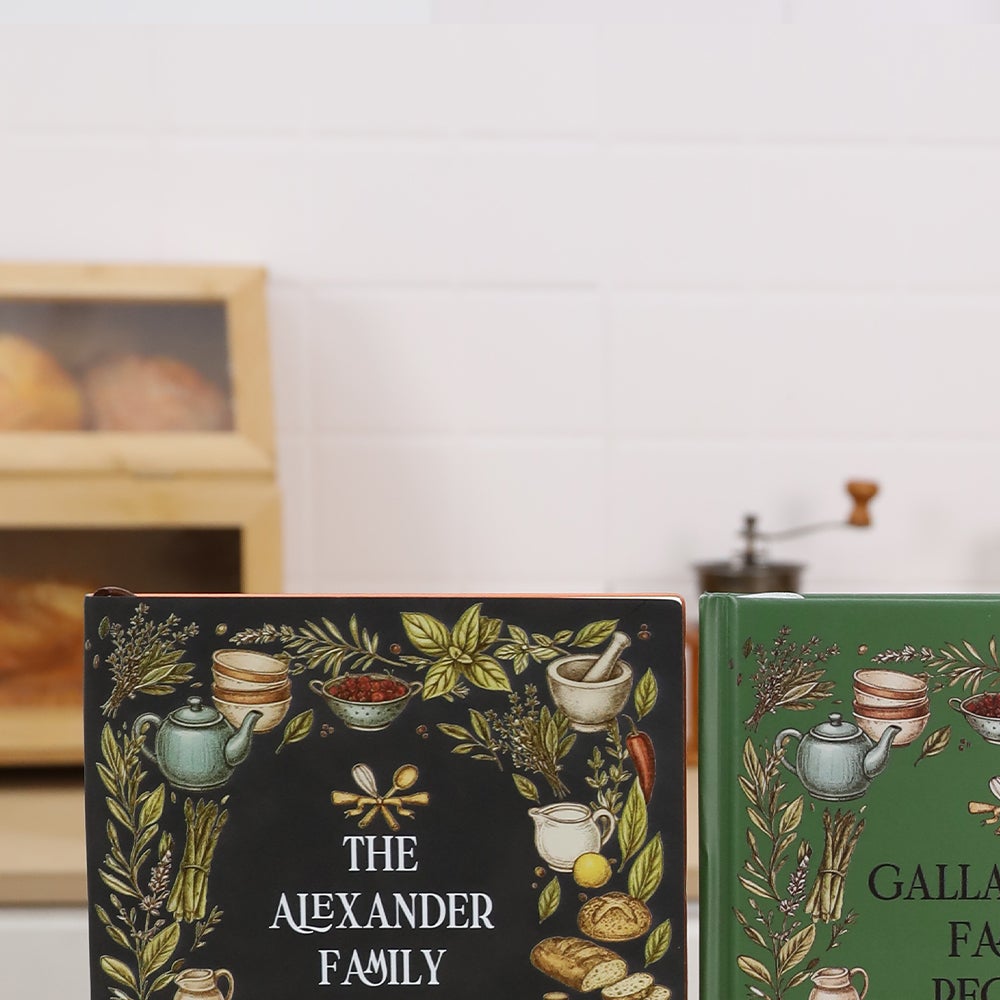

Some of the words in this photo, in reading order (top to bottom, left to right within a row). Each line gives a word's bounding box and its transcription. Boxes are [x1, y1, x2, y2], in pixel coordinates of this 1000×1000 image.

[342, 835, 419, 872] THE
[268, 892, 495, 935] ALEXANDER
[318, 949, 447, 987] FAMILY
